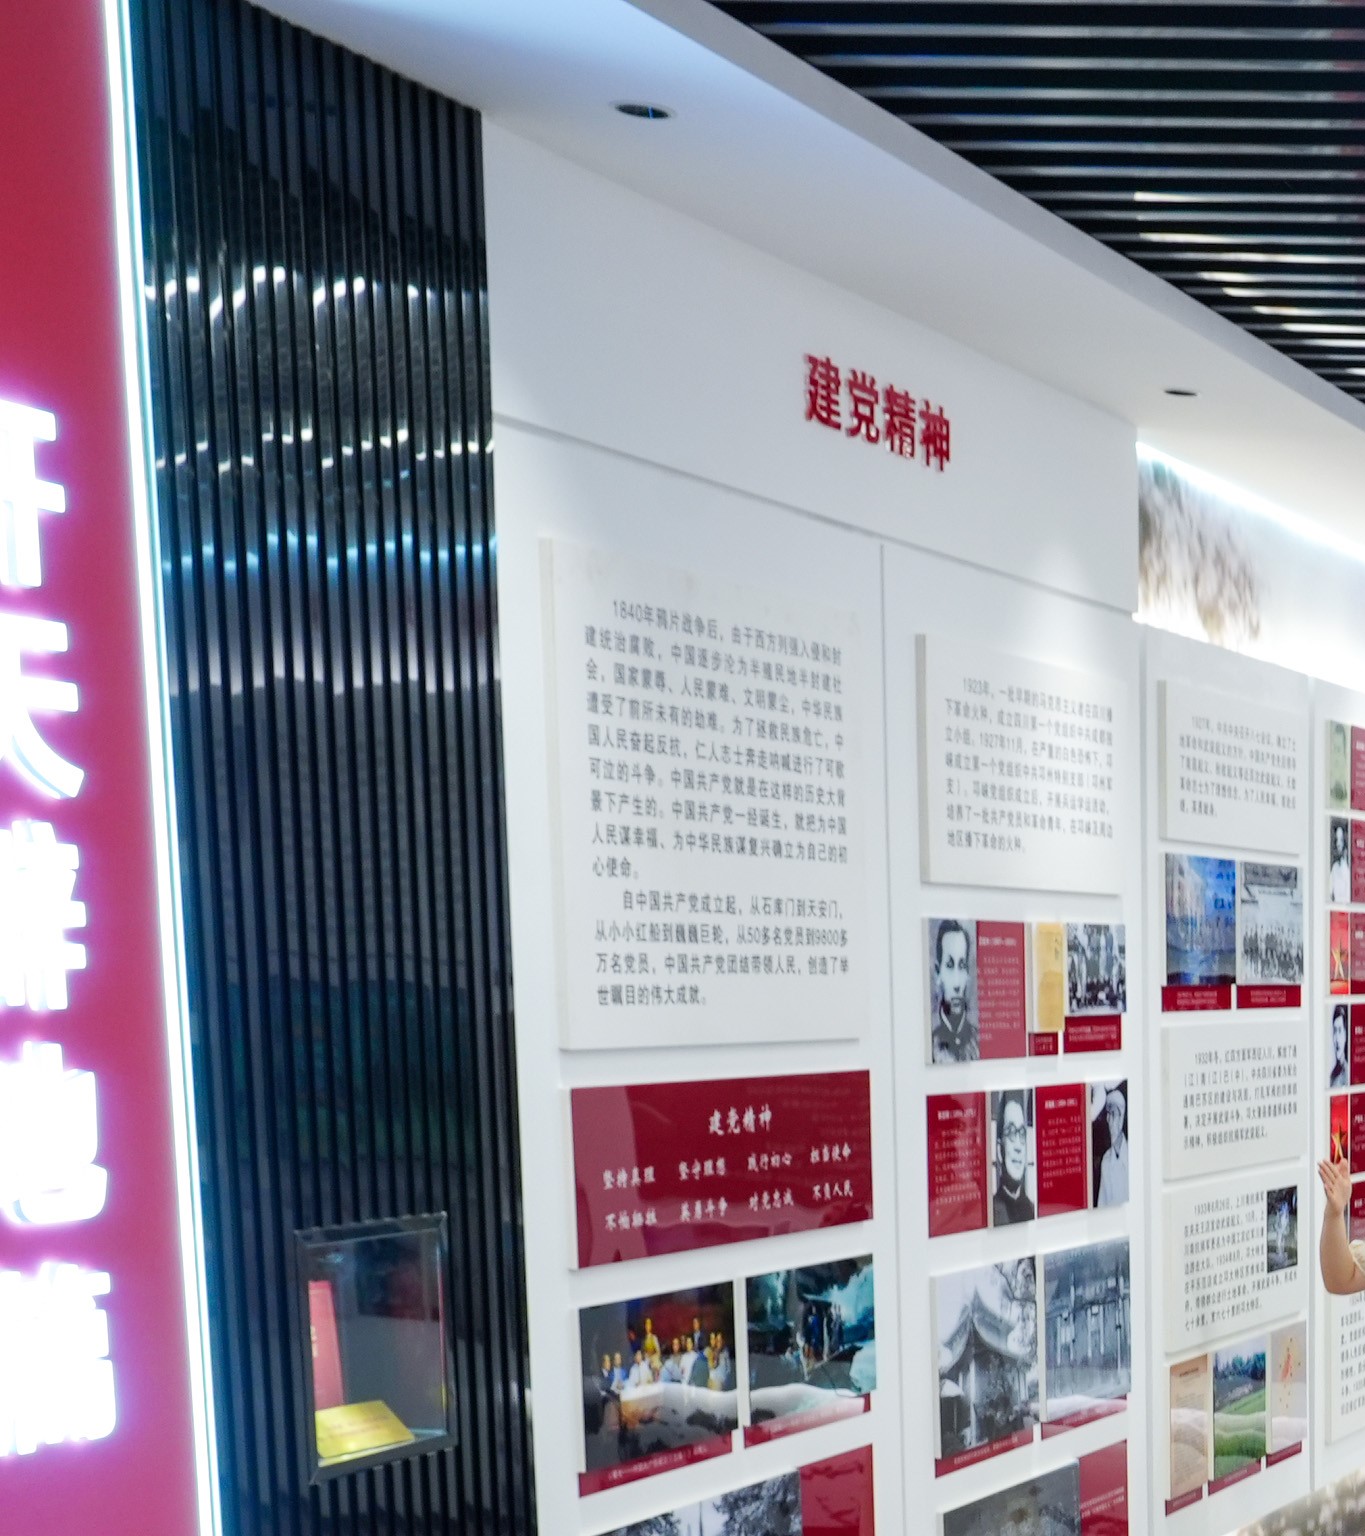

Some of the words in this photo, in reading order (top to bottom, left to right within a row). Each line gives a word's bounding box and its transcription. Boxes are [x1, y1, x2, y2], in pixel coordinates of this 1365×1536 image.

[804, 353, 952, 472] 建党精神
[592, 856, 638, 880] 心使命。
[708, 1103, 773, 1136] 建党精神
